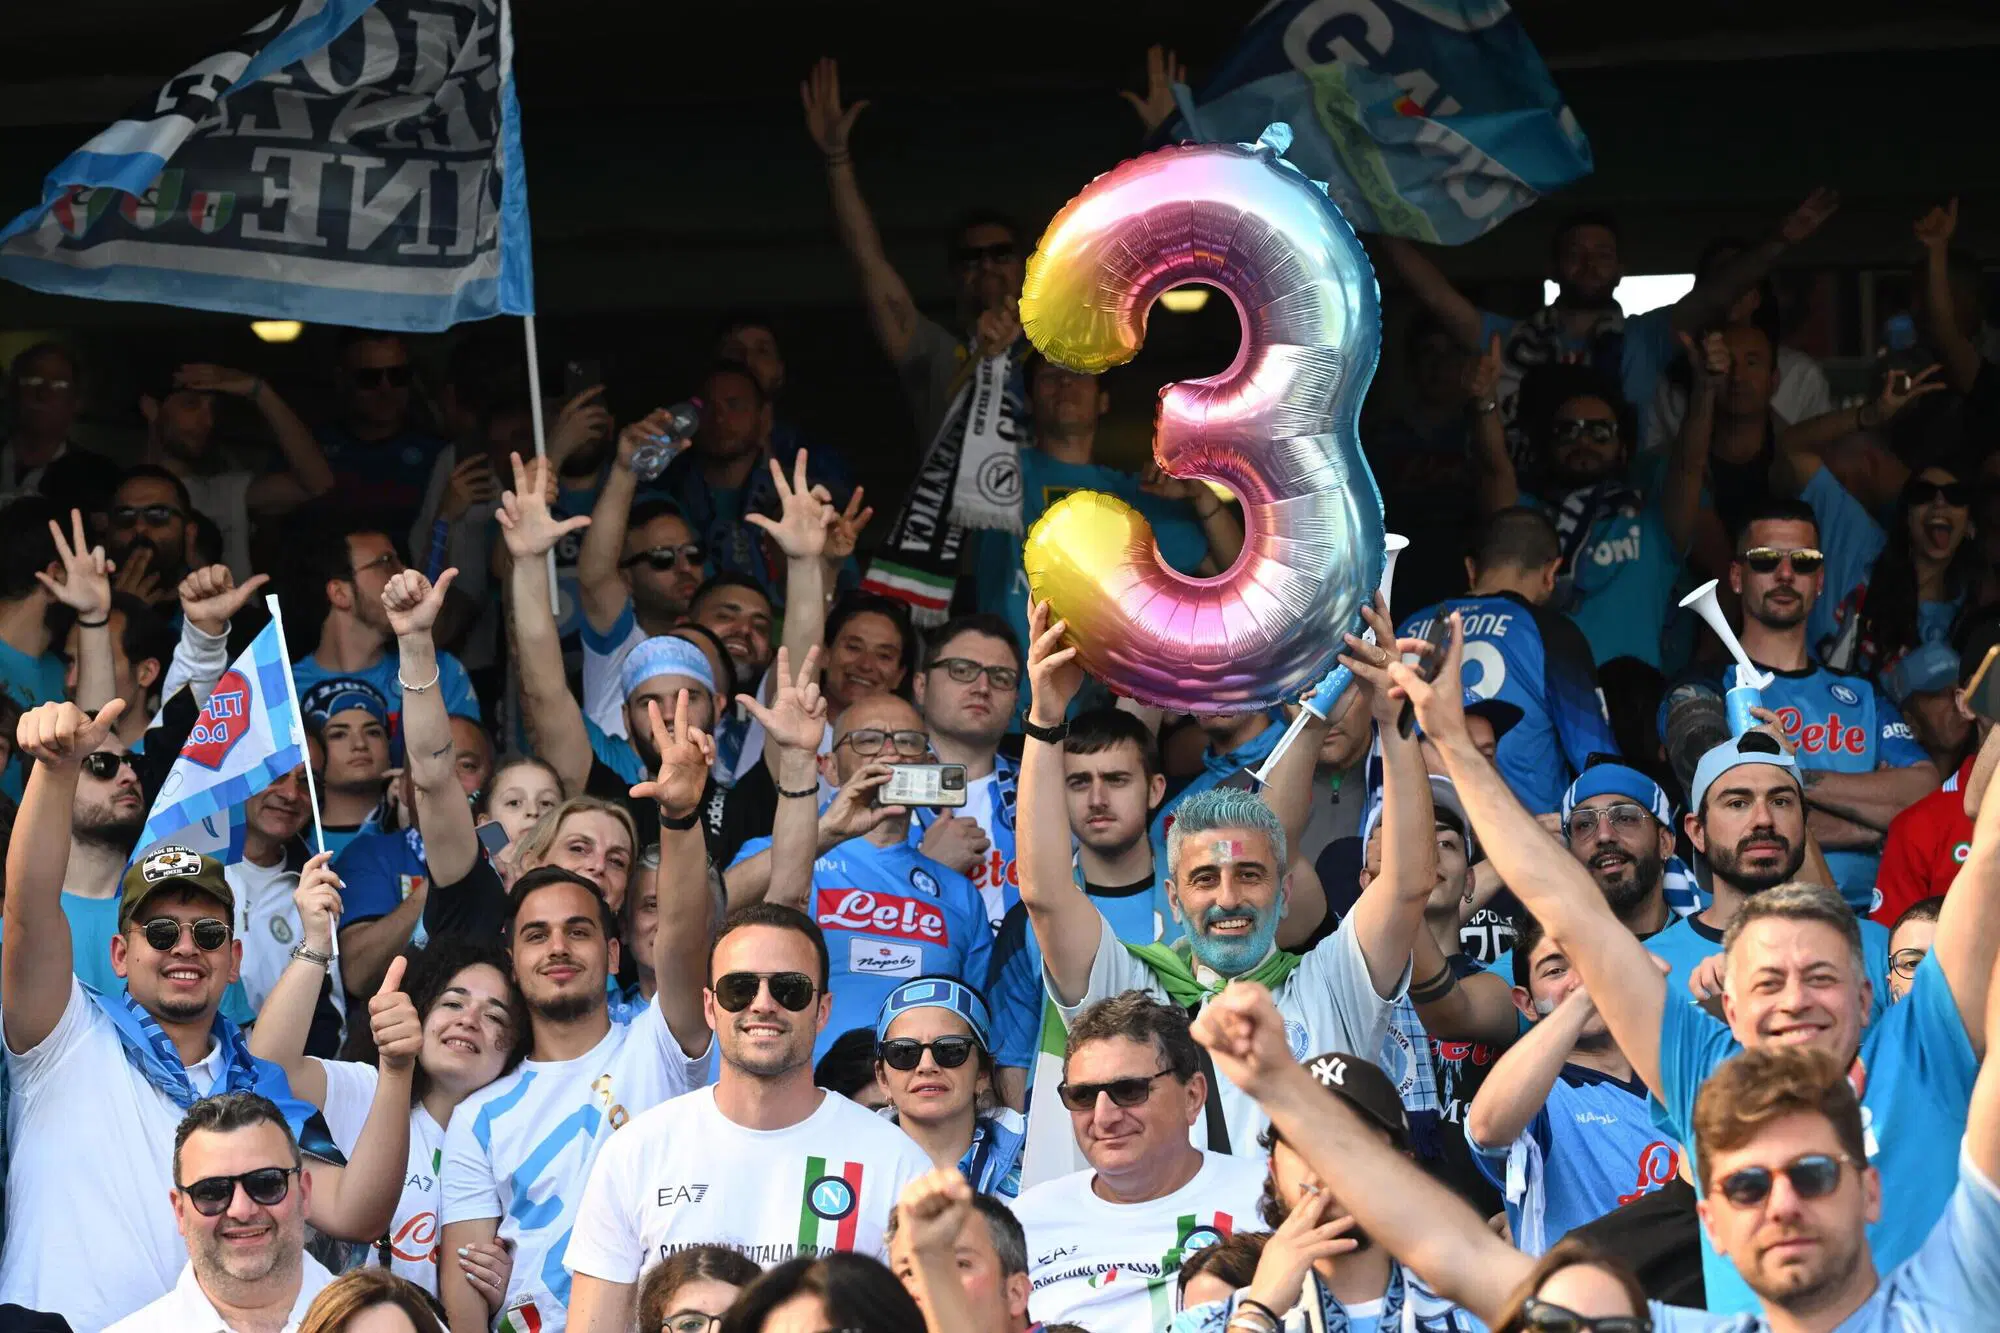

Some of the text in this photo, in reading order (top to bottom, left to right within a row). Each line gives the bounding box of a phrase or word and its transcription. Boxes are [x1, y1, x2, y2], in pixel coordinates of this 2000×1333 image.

[818, 890, 943, 938] Lete
[856, 954, 917, 970] Napoli
[657, 1183, 710, 1208] EA7
